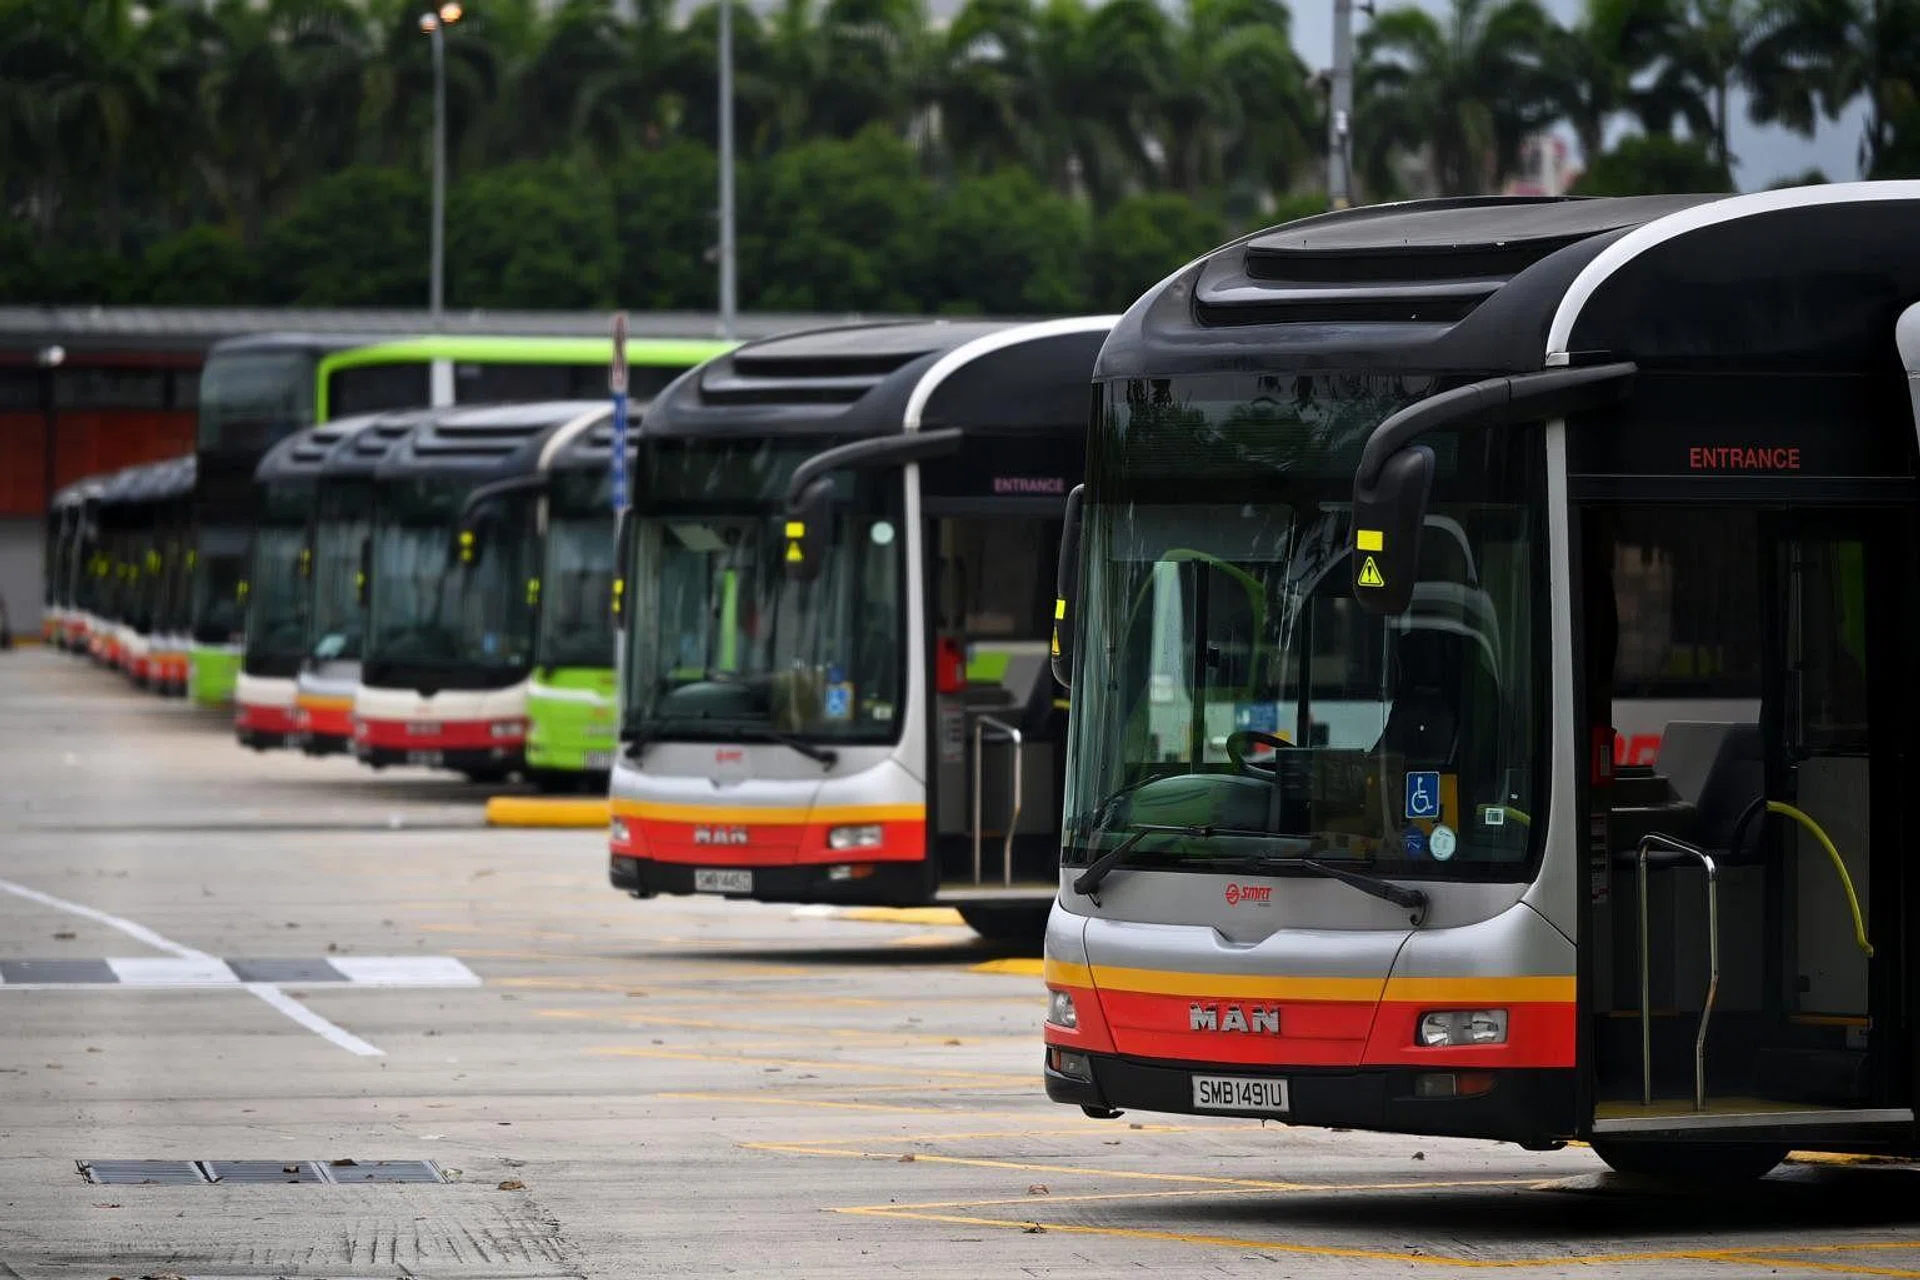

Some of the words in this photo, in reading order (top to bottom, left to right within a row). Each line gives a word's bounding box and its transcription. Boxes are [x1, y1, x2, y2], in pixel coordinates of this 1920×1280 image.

[1689, 447, 1801, 469] ENTRANCE
[994, 477, 1064, 493] ENTRANCE
[694, 828, 748, 845] MAN
[1189, 1003, 1280, 1034] MAN
[1200, 1080, 1283, 1107] SMB1491U
